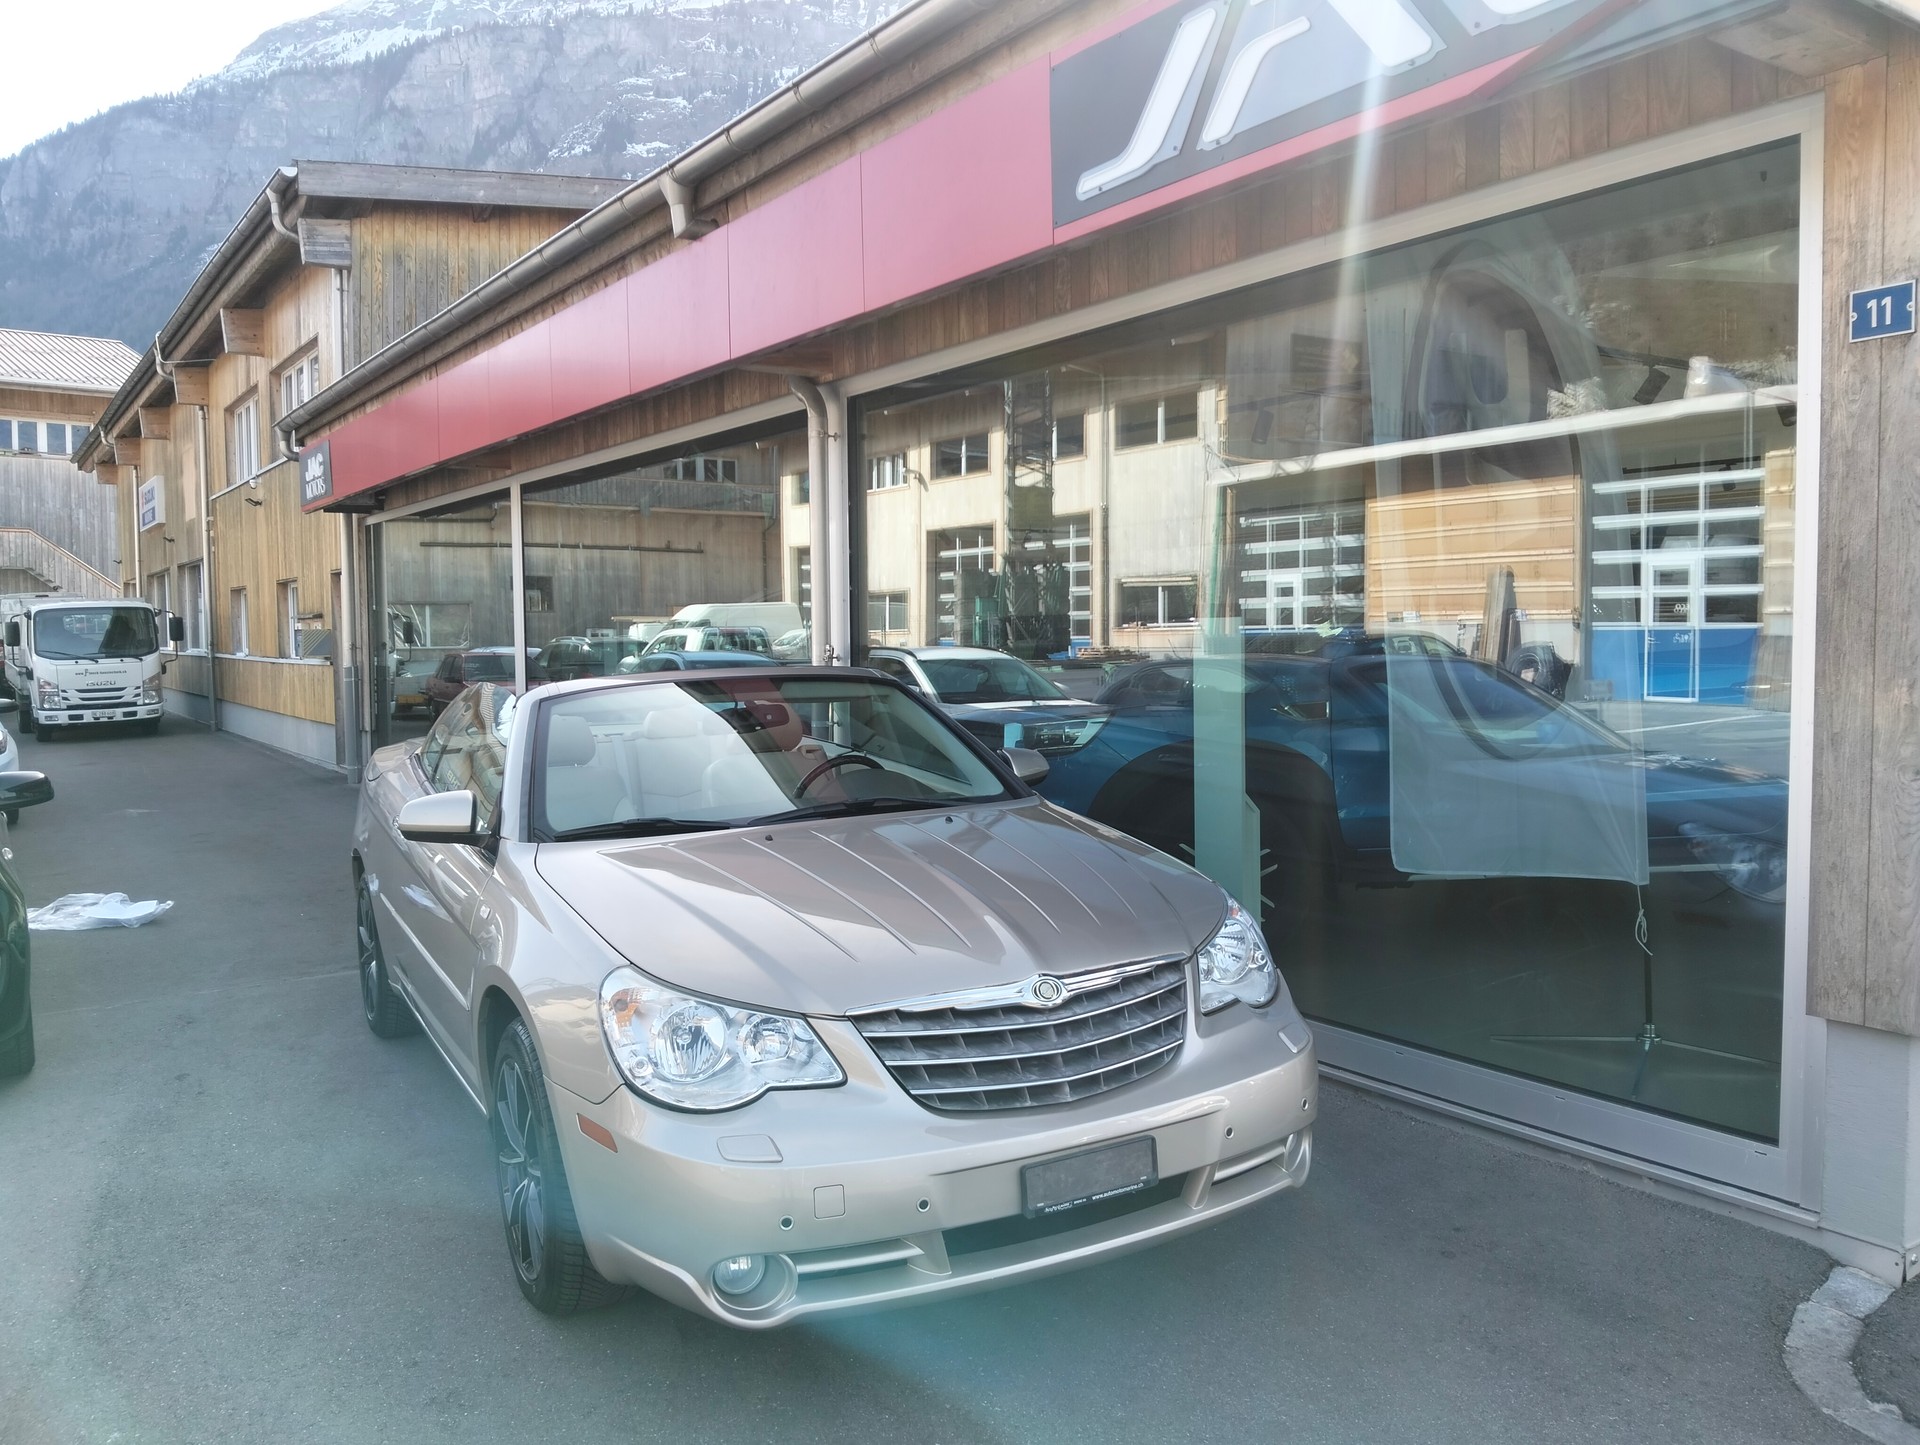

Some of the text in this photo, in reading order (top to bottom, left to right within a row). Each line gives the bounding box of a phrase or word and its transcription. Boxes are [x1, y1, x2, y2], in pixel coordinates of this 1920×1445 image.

[1077, 0, 1550, 198] JA
[1866, 295, 1892, 329] 11
[305, 452, 324, 482] JAC
